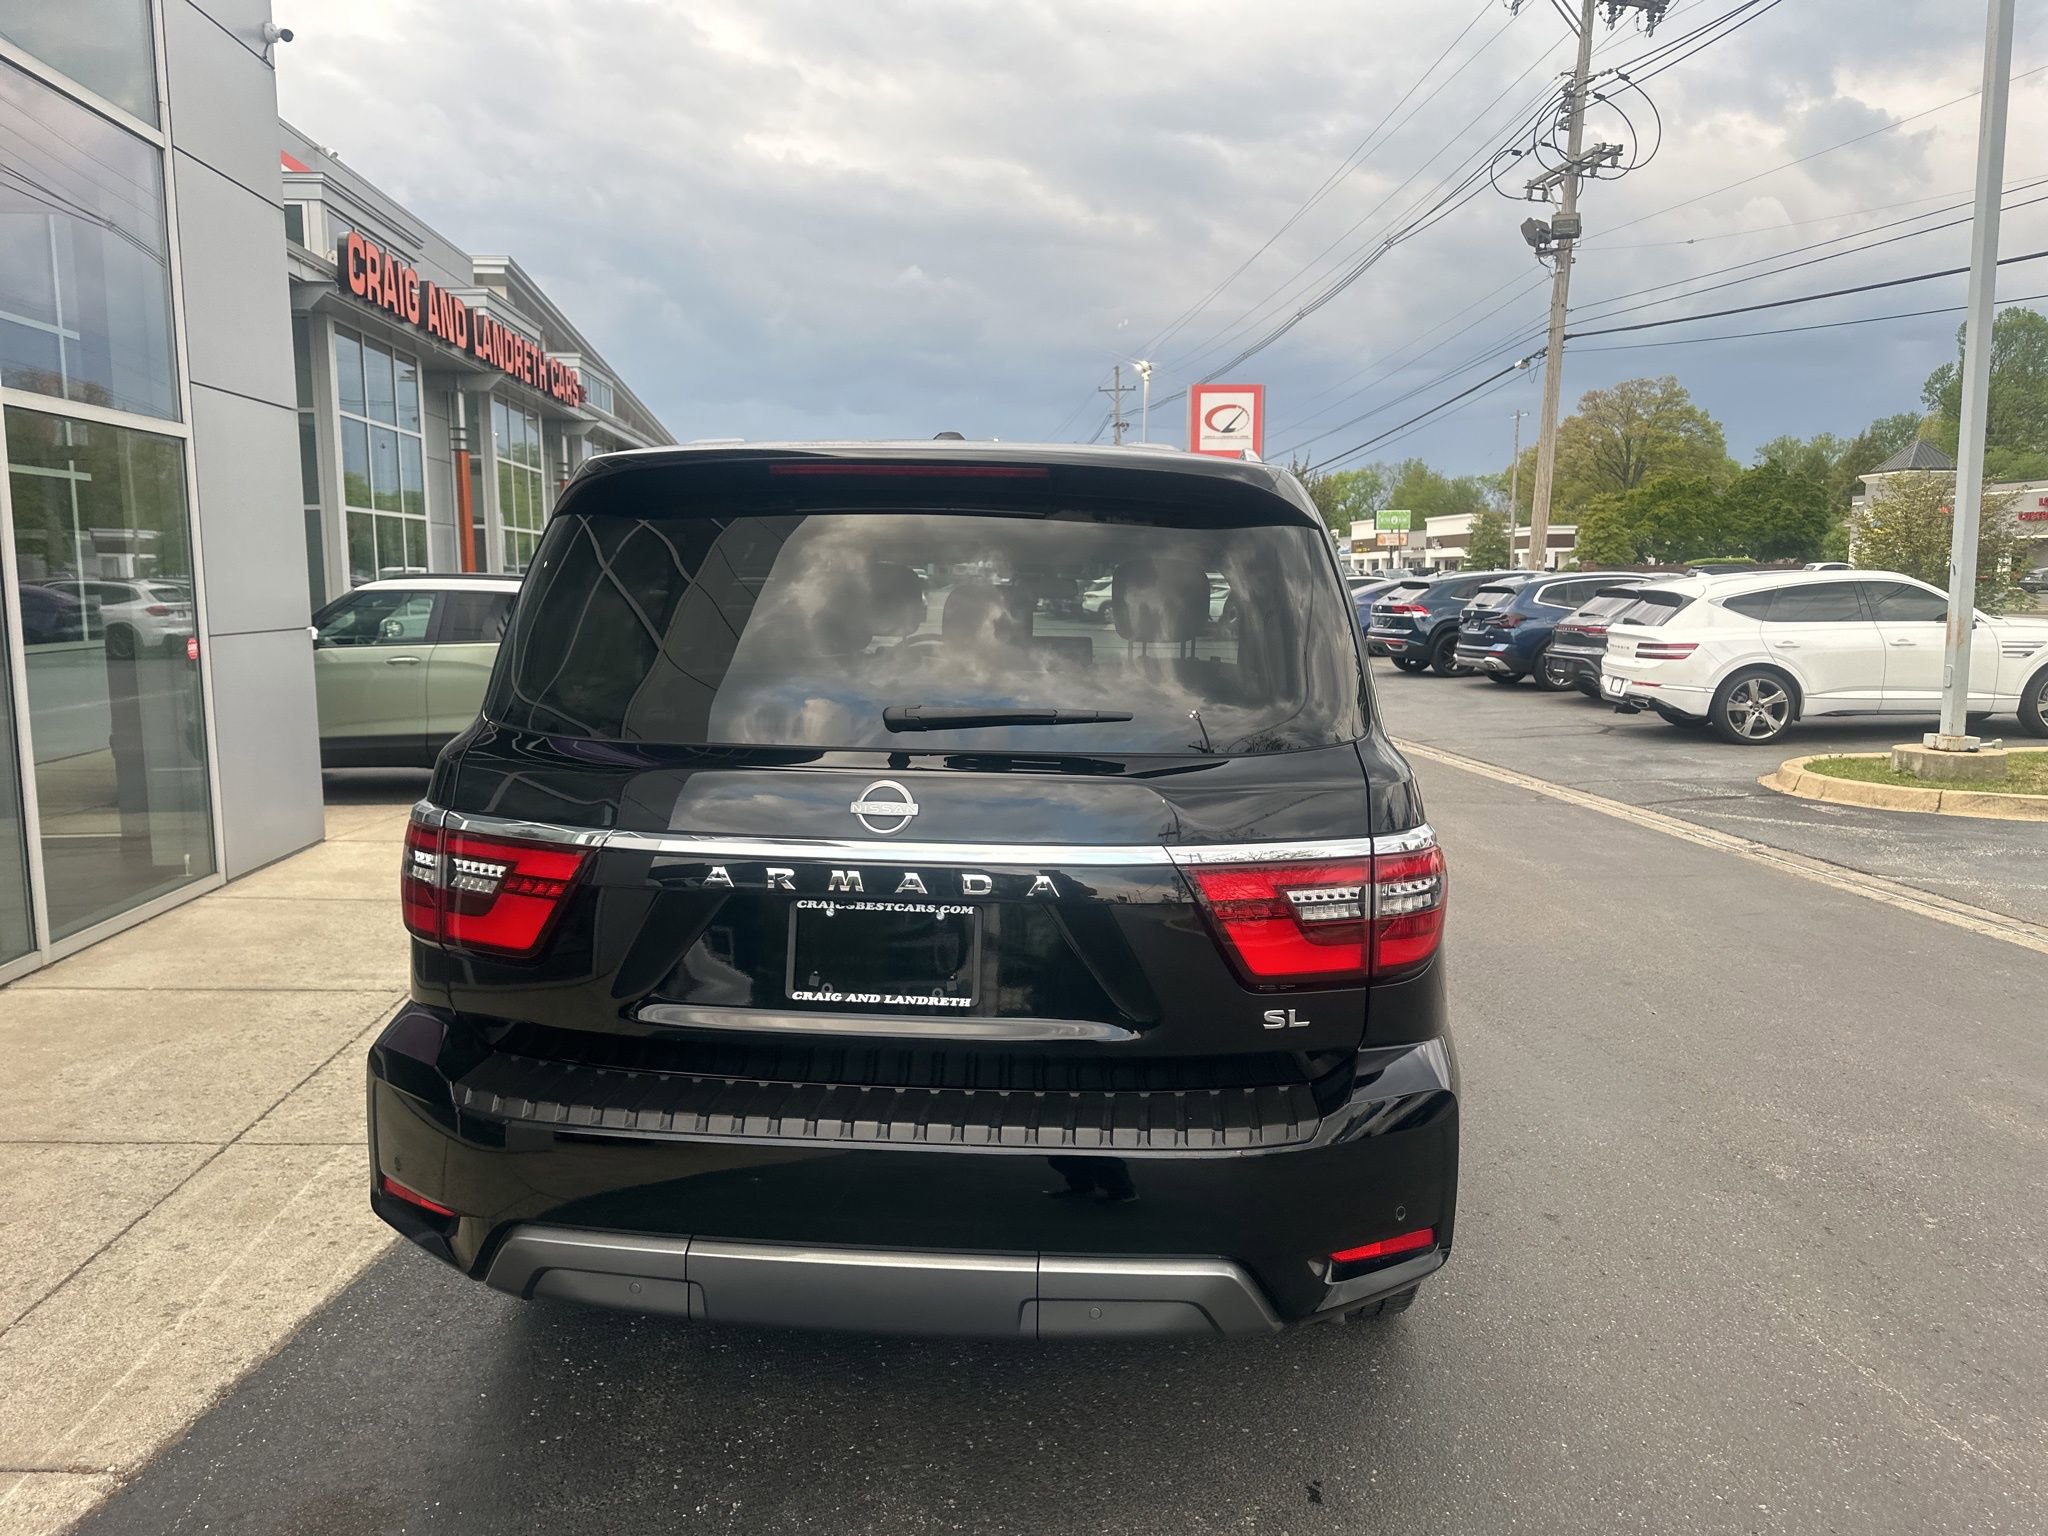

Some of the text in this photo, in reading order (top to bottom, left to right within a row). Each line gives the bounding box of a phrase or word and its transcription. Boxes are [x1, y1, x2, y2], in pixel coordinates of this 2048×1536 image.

[346, 232, 580, 408] CRAIG AND LANDRETH CARS
[851, 803, 918, 815] NISSAN
[703, 865, 1061, 897] ARMADA
[791, 991, 972, 1008] CRAIG AND LANDRETH
[1262, 1008, 1311, 1030] SL
